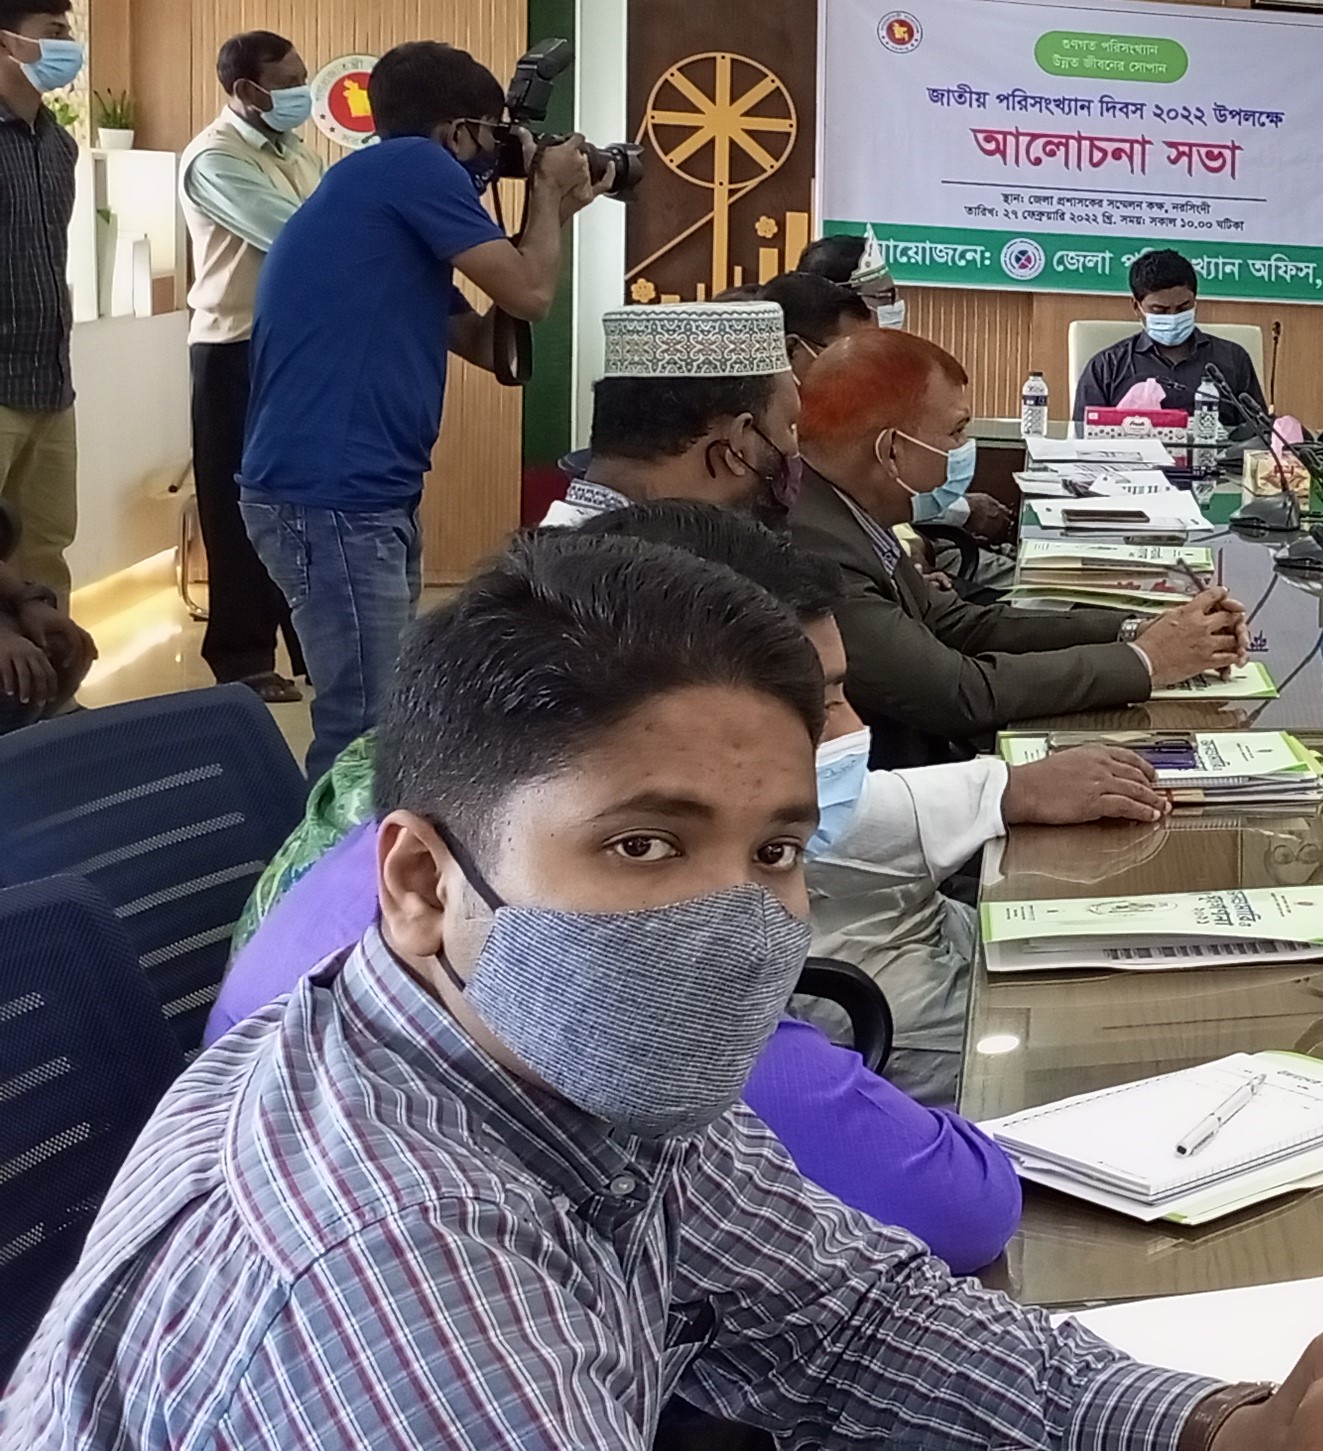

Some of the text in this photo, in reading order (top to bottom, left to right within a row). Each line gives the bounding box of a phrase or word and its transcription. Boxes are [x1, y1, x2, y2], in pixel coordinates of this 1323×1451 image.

[1101, 38, 1159, 56] পরিসংখ্যান
[1052, 54, 1168, 74] উন্নত জীবনের সোপান
[926, 83, 1285, 129] জাতীয় পরিসংখ্যান দিবস ২০২২ উপলক্ষে
[969, 126, 1244, 181] আলোচনা সভা
[1028, 194, 1054, 206] জেলা
[1171, 200, 1212, 215] নরসিংদী
[1003, 208, 1019, 220] ২৭
[1069, 212, 1100, 225] ২০২২
[1149, 216, 1178, 228] সকাল
[1216, 217, 1245, 232] ঘটিকা
[1053, 250, 1114, 275] জেলা
[1248, 253, 1323, 290] অফিস,
